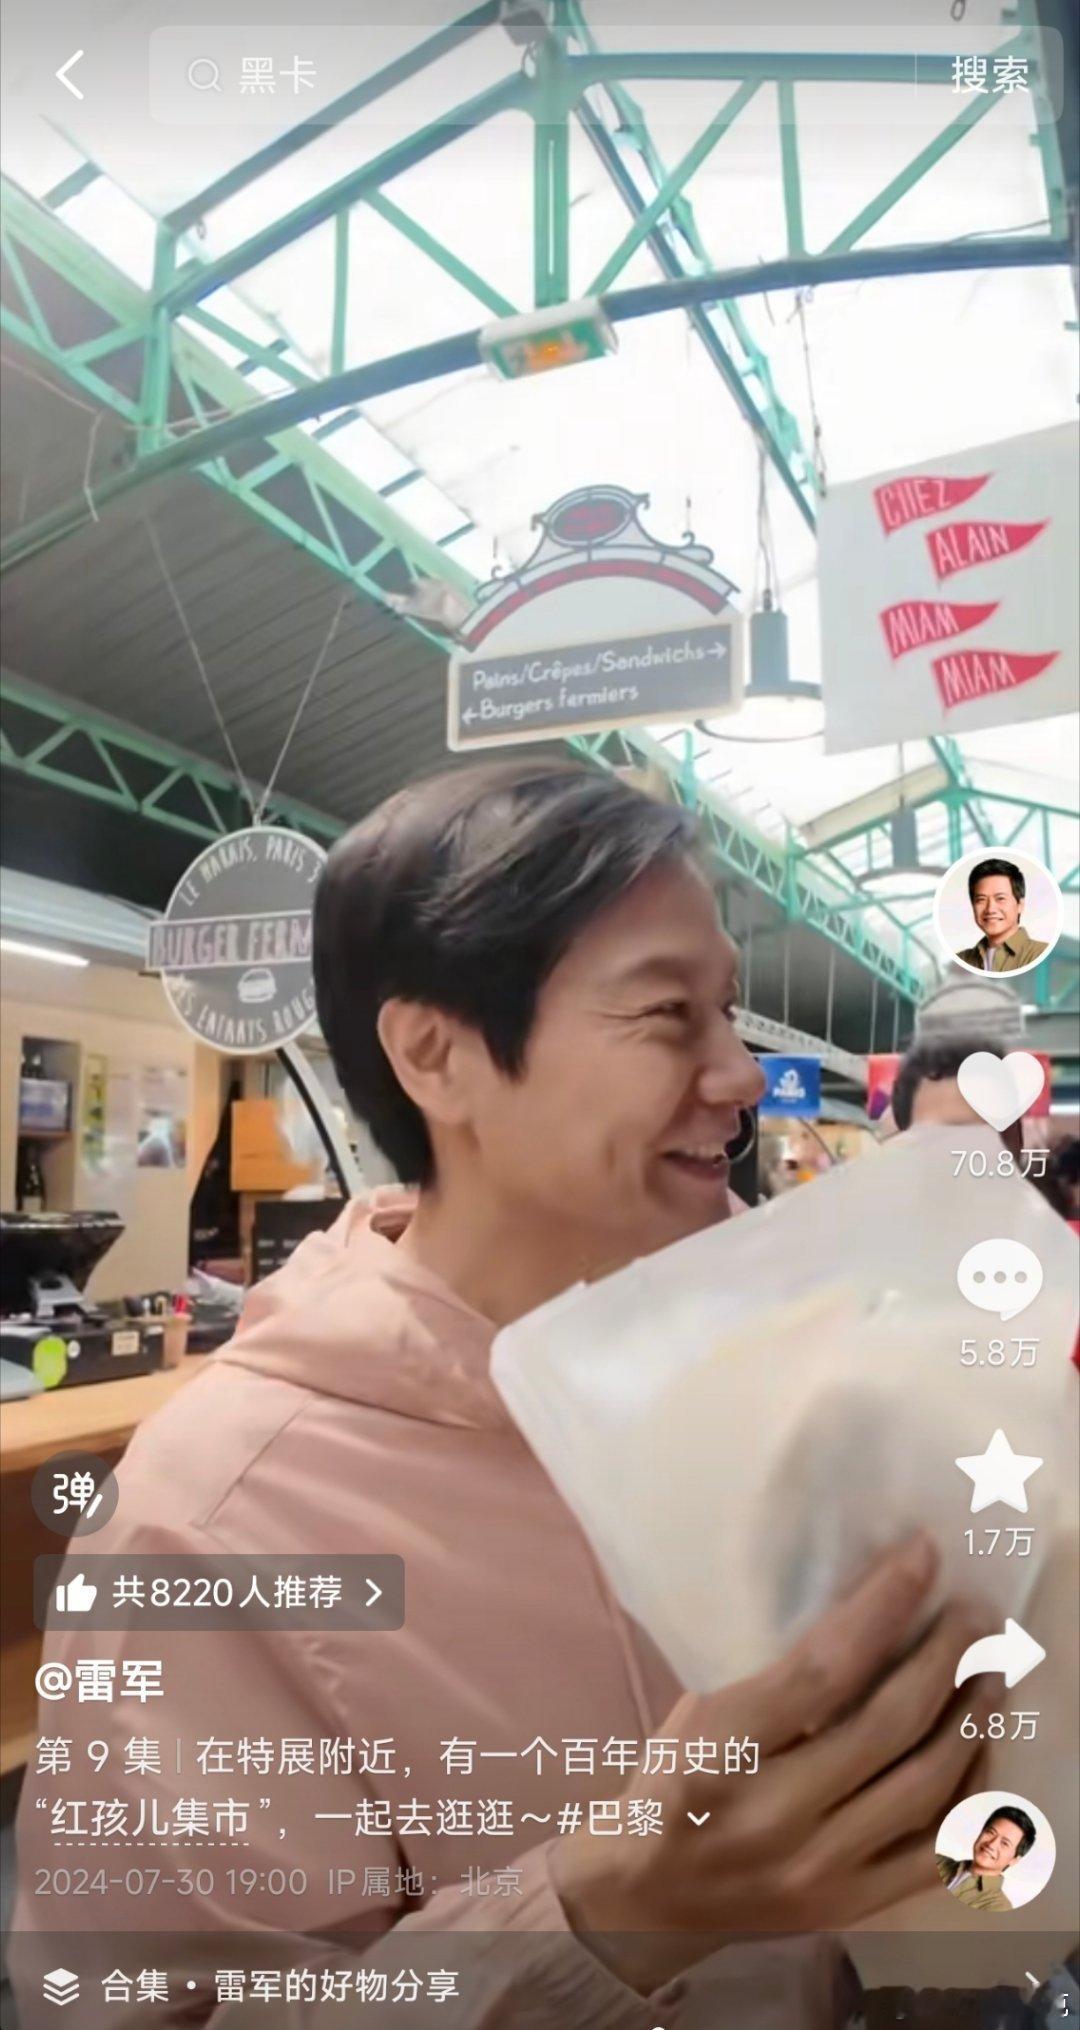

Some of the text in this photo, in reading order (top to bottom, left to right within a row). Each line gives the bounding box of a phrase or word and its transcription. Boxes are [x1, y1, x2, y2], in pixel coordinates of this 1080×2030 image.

[880, 479, 949, 533] CHEZ
[934, 526, 1010, 580] ALAIN
[888, 603, 959, 656] MIAM
[480, 685, 639, 720] Burgers fermiers
[941, 654, 1016, 706] MIAM
[178, 880, 200, 907] LE
[265, 834, 304, 873] PARIS
[152, 922, 239, 968] BURGER
